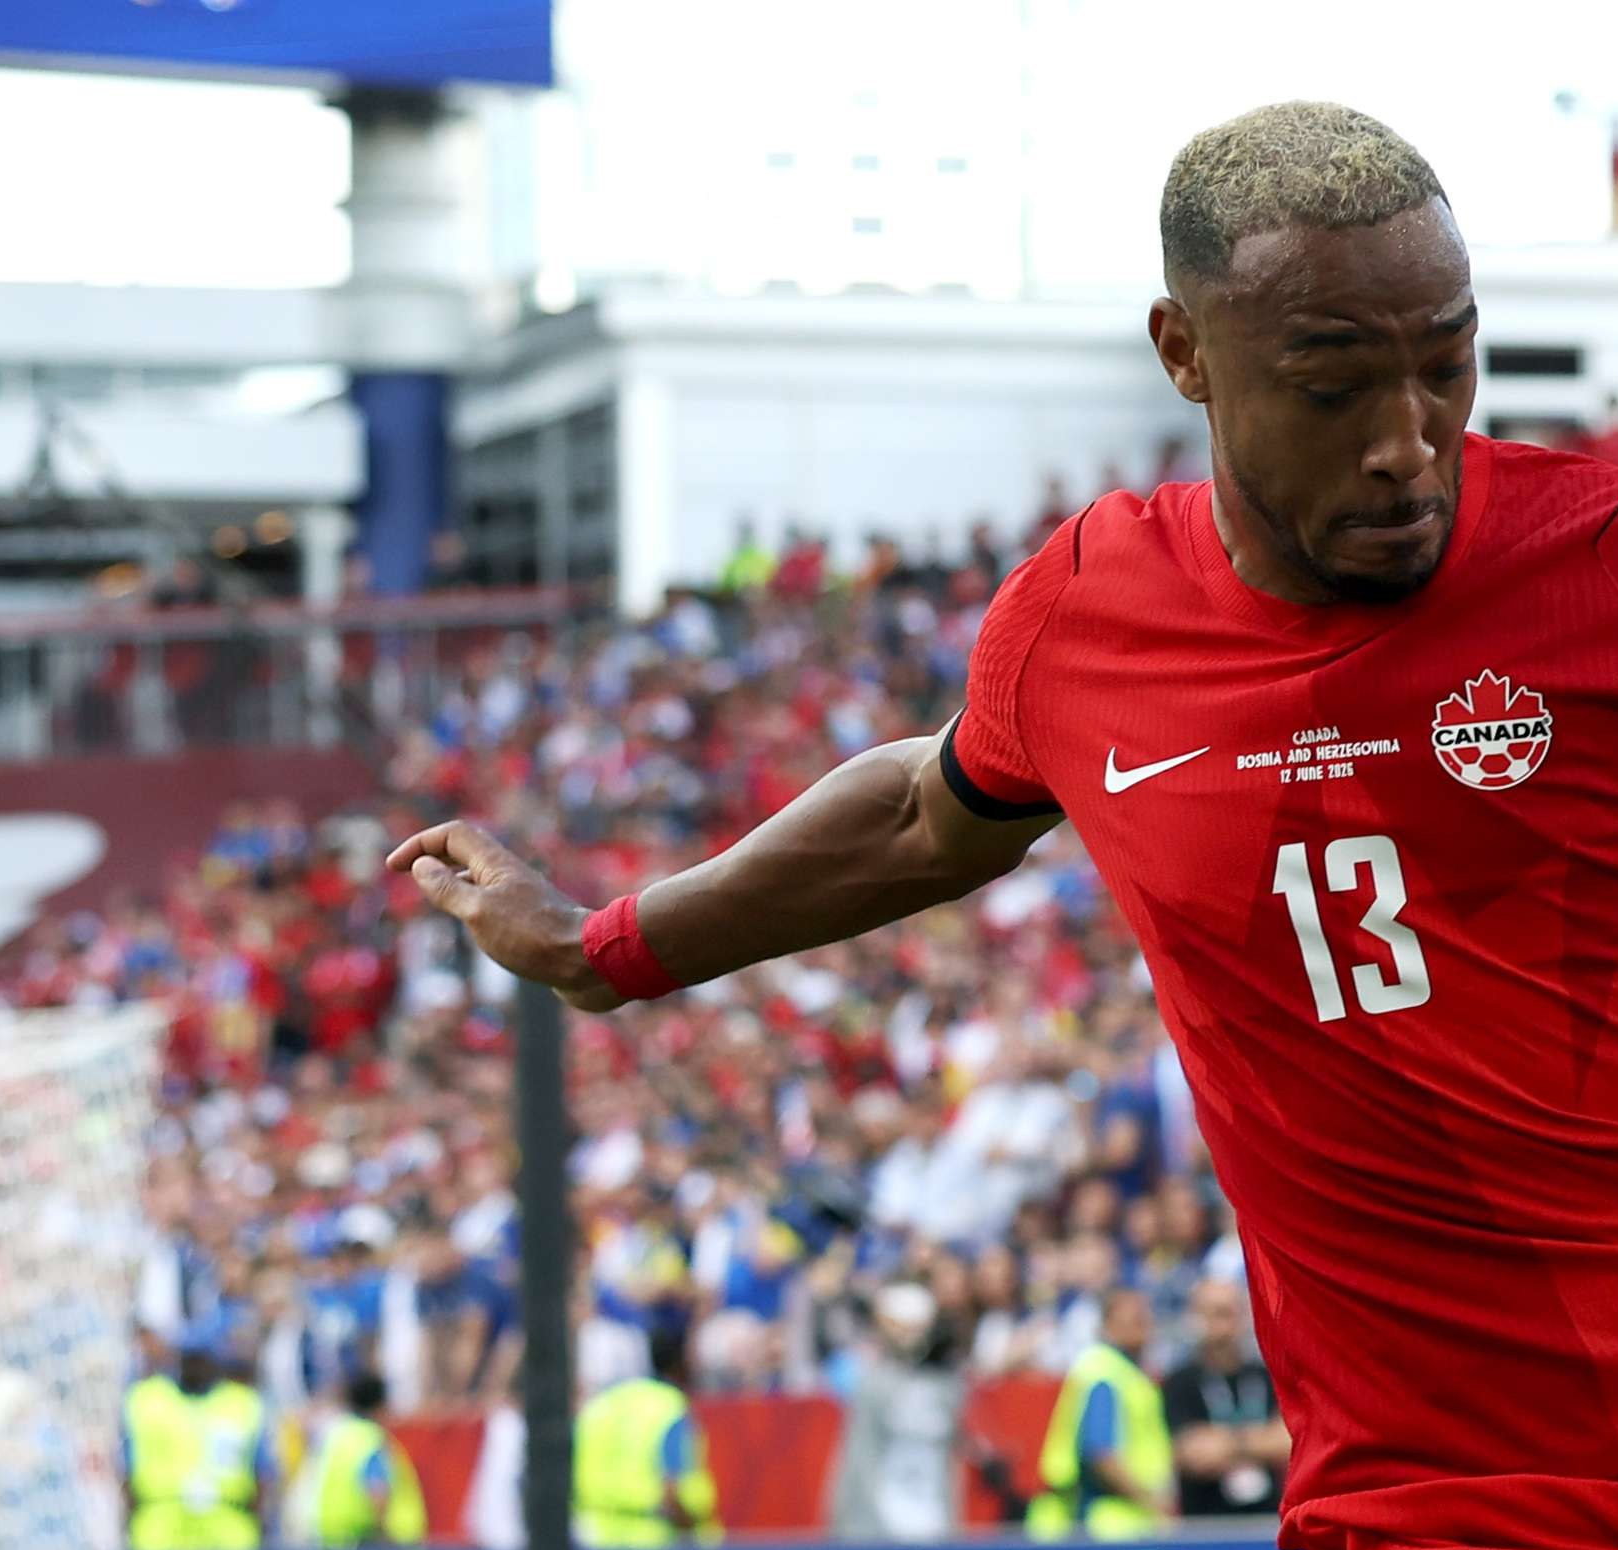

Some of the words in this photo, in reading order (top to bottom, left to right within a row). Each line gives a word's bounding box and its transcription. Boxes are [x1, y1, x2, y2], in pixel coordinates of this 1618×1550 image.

[1292, 726, 1341, 745] CANADA
[1435, 720, 1549, 747] CANADA
[1236, 751, 1283, 770] BOSNIA
[1286, 748, 1312, 764] AND
[1316, 738, 1401, 761] HERZEGOVINA
[1279, 768, 1292, 784] 12
[1295, 765, 1324, 782] JUNE
[1272, 834, 1431, 1023] 13
